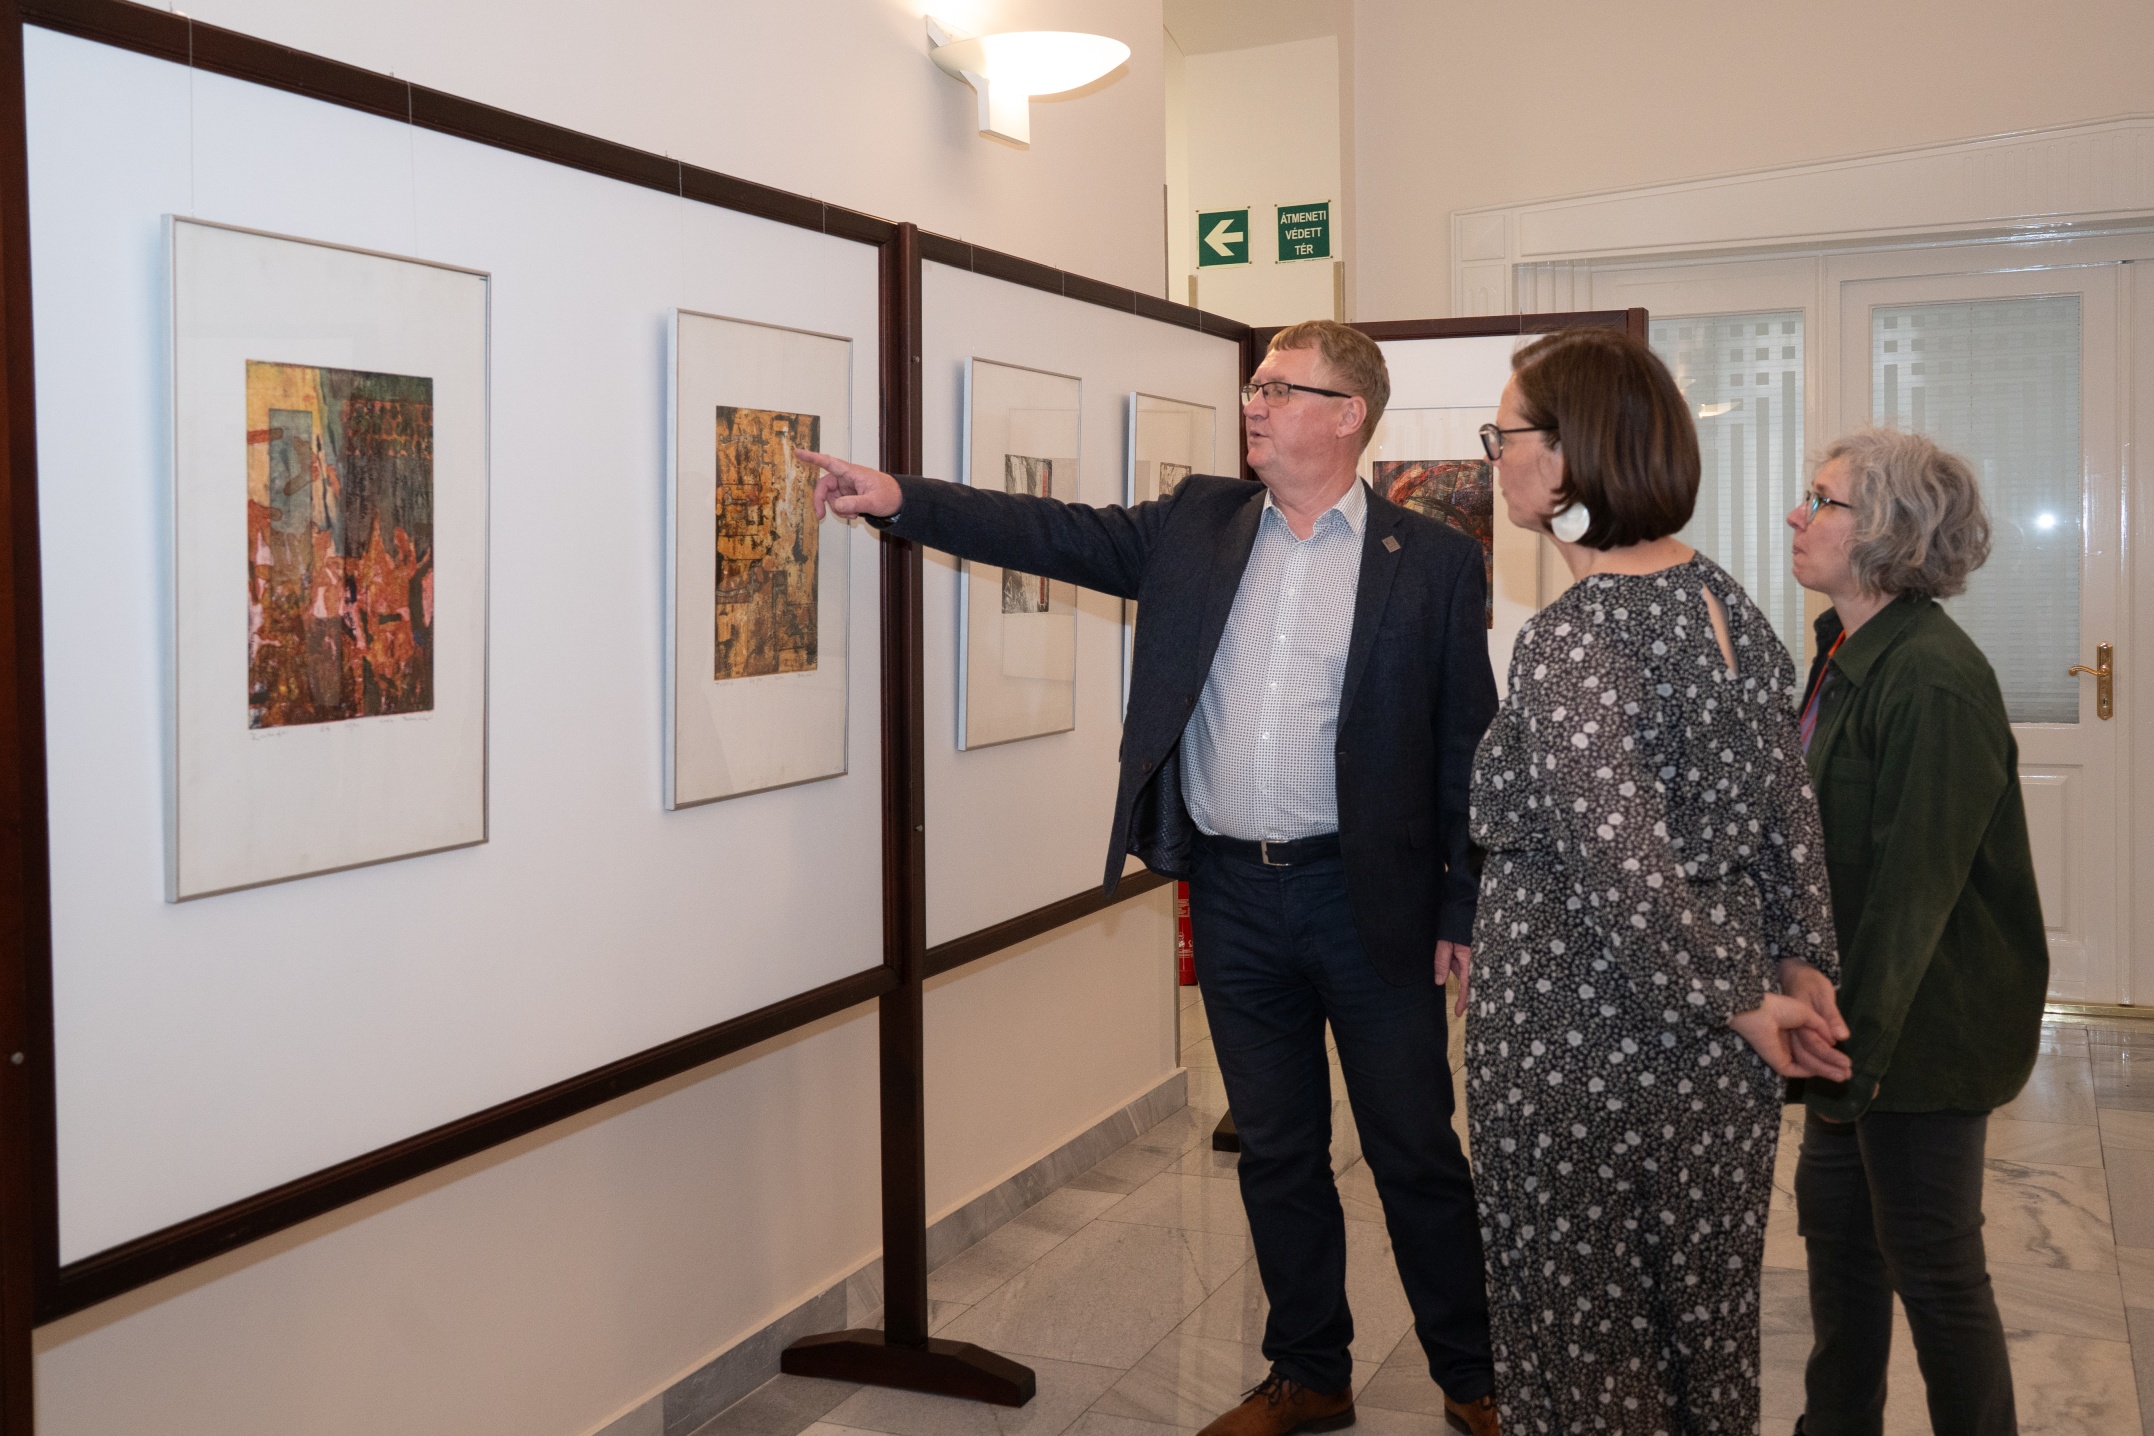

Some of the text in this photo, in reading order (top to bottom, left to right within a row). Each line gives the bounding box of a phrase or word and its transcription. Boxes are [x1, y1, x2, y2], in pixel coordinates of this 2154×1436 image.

[1280, 210, 1326, 224] ÁTMENETI
[1285, 227, 1322, 240] VÉDETT
[1295, 243, 1313, 255] TÉR
